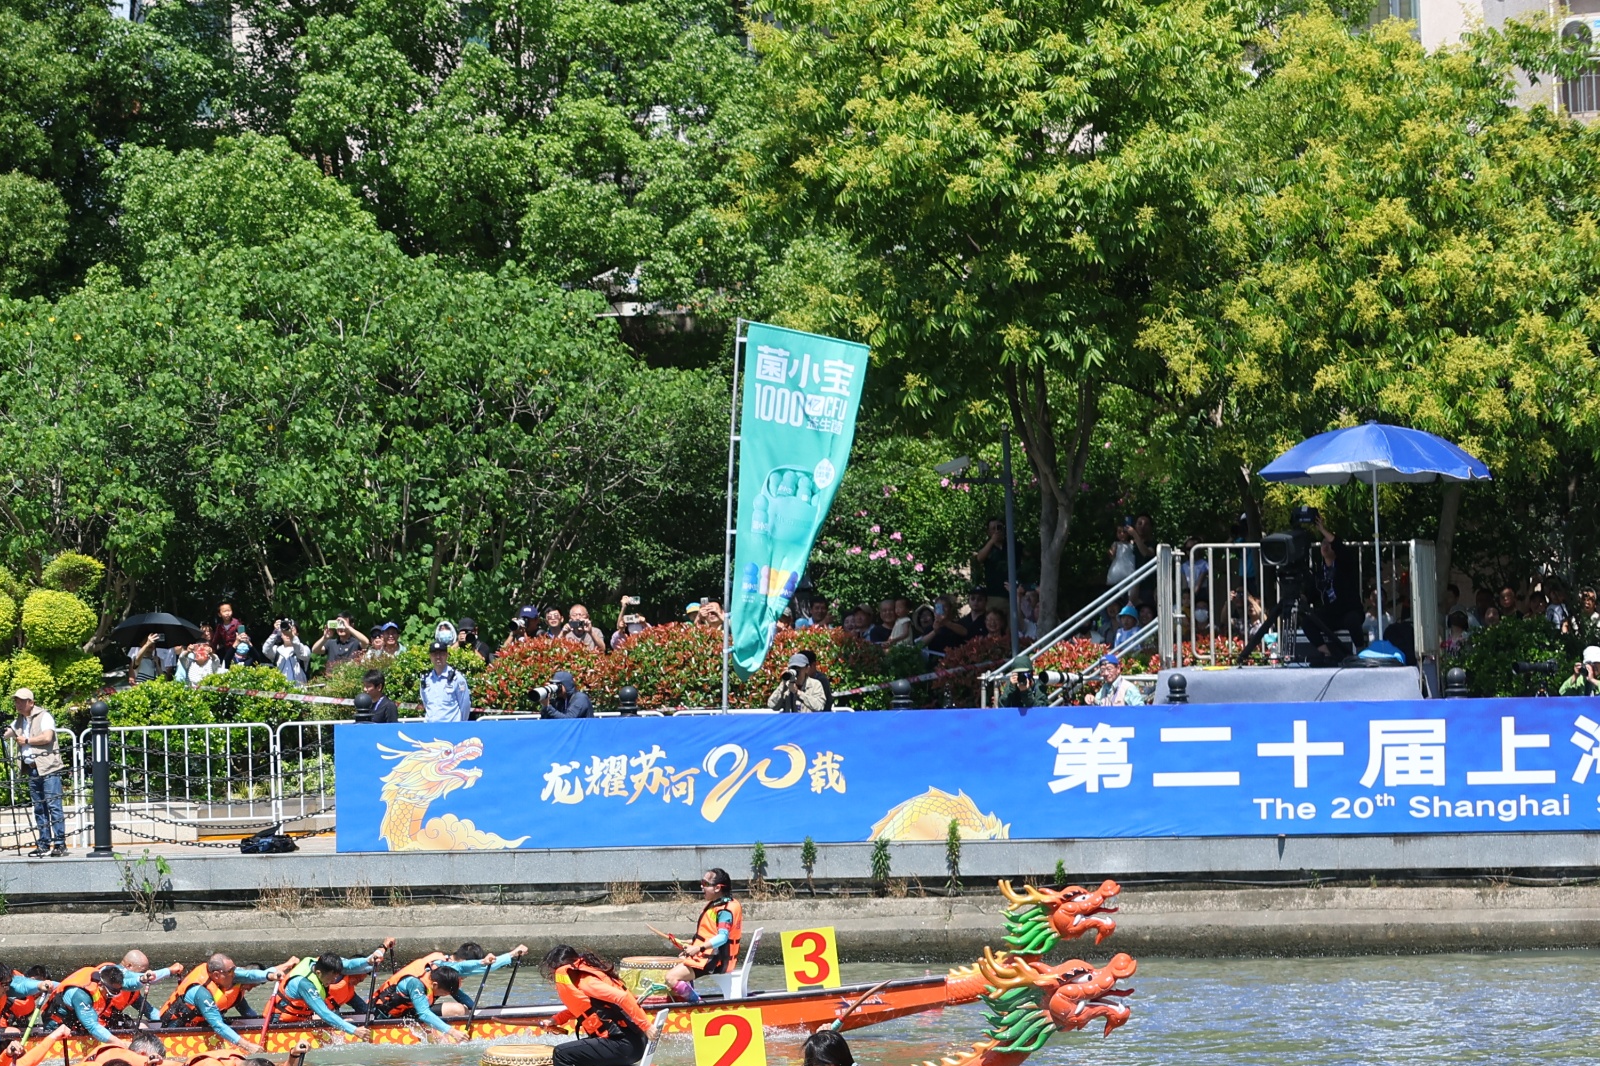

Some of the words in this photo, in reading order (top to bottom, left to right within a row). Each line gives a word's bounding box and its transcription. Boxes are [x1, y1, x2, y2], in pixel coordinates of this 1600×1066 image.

[756, 345, 855, 397] 菌小宝
[806, 417, 844, 435] 益生菌
[1253, 797, 1317, 820] The
[1331, 792, 1395, 819] 20th
[1409, 793, 1570, 822] Shanghai
[790, 931, 830, 984] 3
